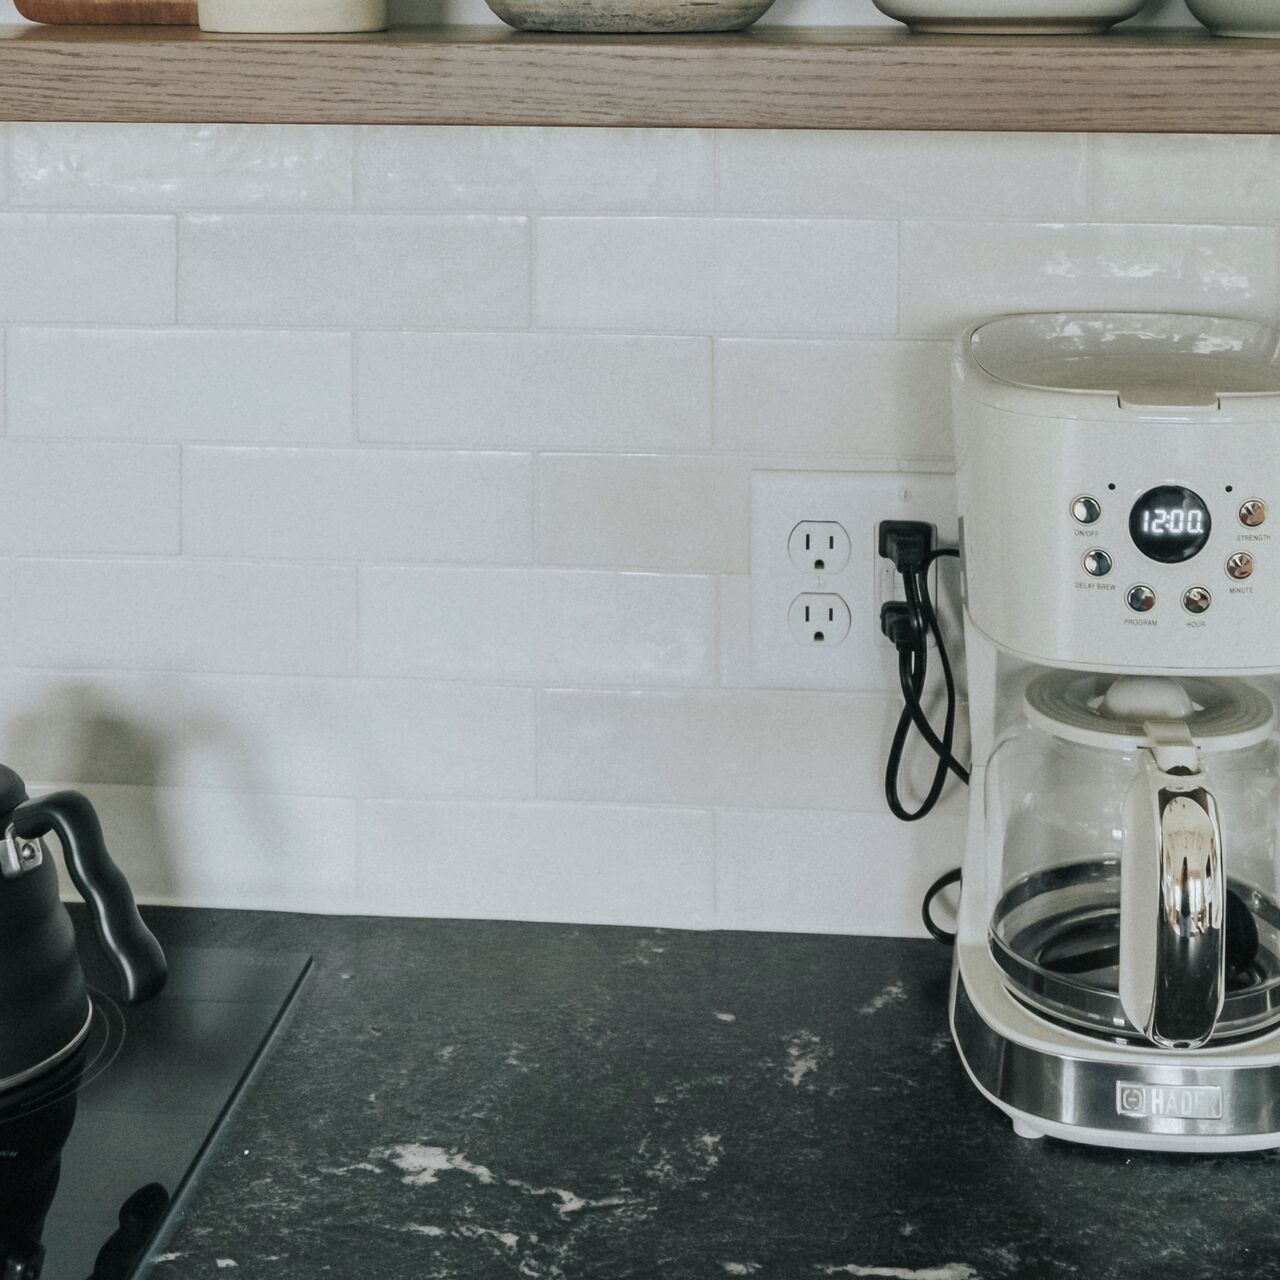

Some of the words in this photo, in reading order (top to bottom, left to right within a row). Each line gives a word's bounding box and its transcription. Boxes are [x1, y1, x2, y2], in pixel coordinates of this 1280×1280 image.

[1236, 534, 1271, 542] STRENGTH
[1074, 582, 1095, 590] DELAY
[1096, 583, 1117, 591] BREW
[1124, 618, 1157, 626] PROGRAM
[1151, 1088, 1219, 1115] HAD
